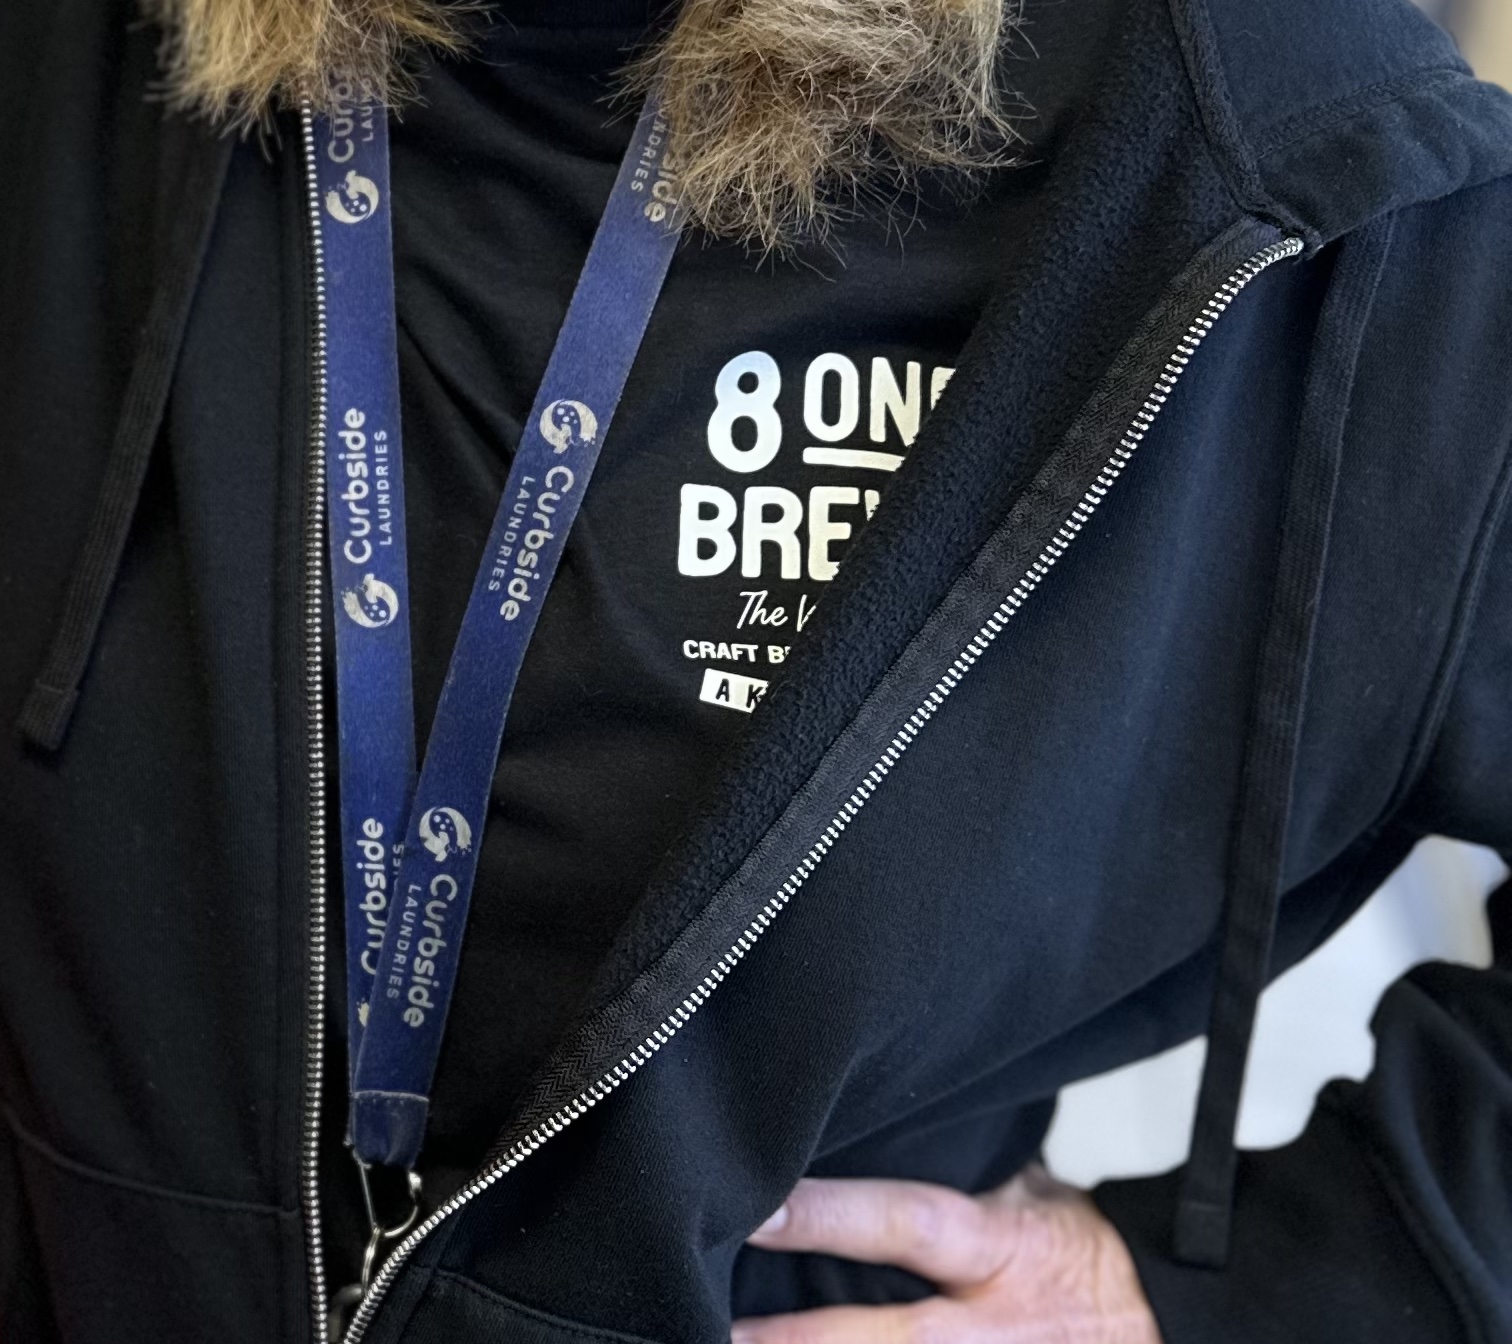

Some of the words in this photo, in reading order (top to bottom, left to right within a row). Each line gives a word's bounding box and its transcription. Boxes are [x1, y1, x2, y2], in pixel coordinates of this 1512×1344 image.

[644, 153, 678, 223] side
[707, 350, 783, 474] 8
[337, 407, 373, 565] Curbside
[374, 429, 393, 546] LAUNDRIES
[488, 475, 536, 592] LAUNDRIES
[499, 465, 575, 622] Curbside
[677, 482, 881, 581] BRE
[682, 639, 759, 663] CRAFT
[736, 589, 789, 630] The
[796, 593, 817, 633] V
[386, 883, 423, 1000] LAUNDRIES
[402, 873, 459, 1029] Curbside
